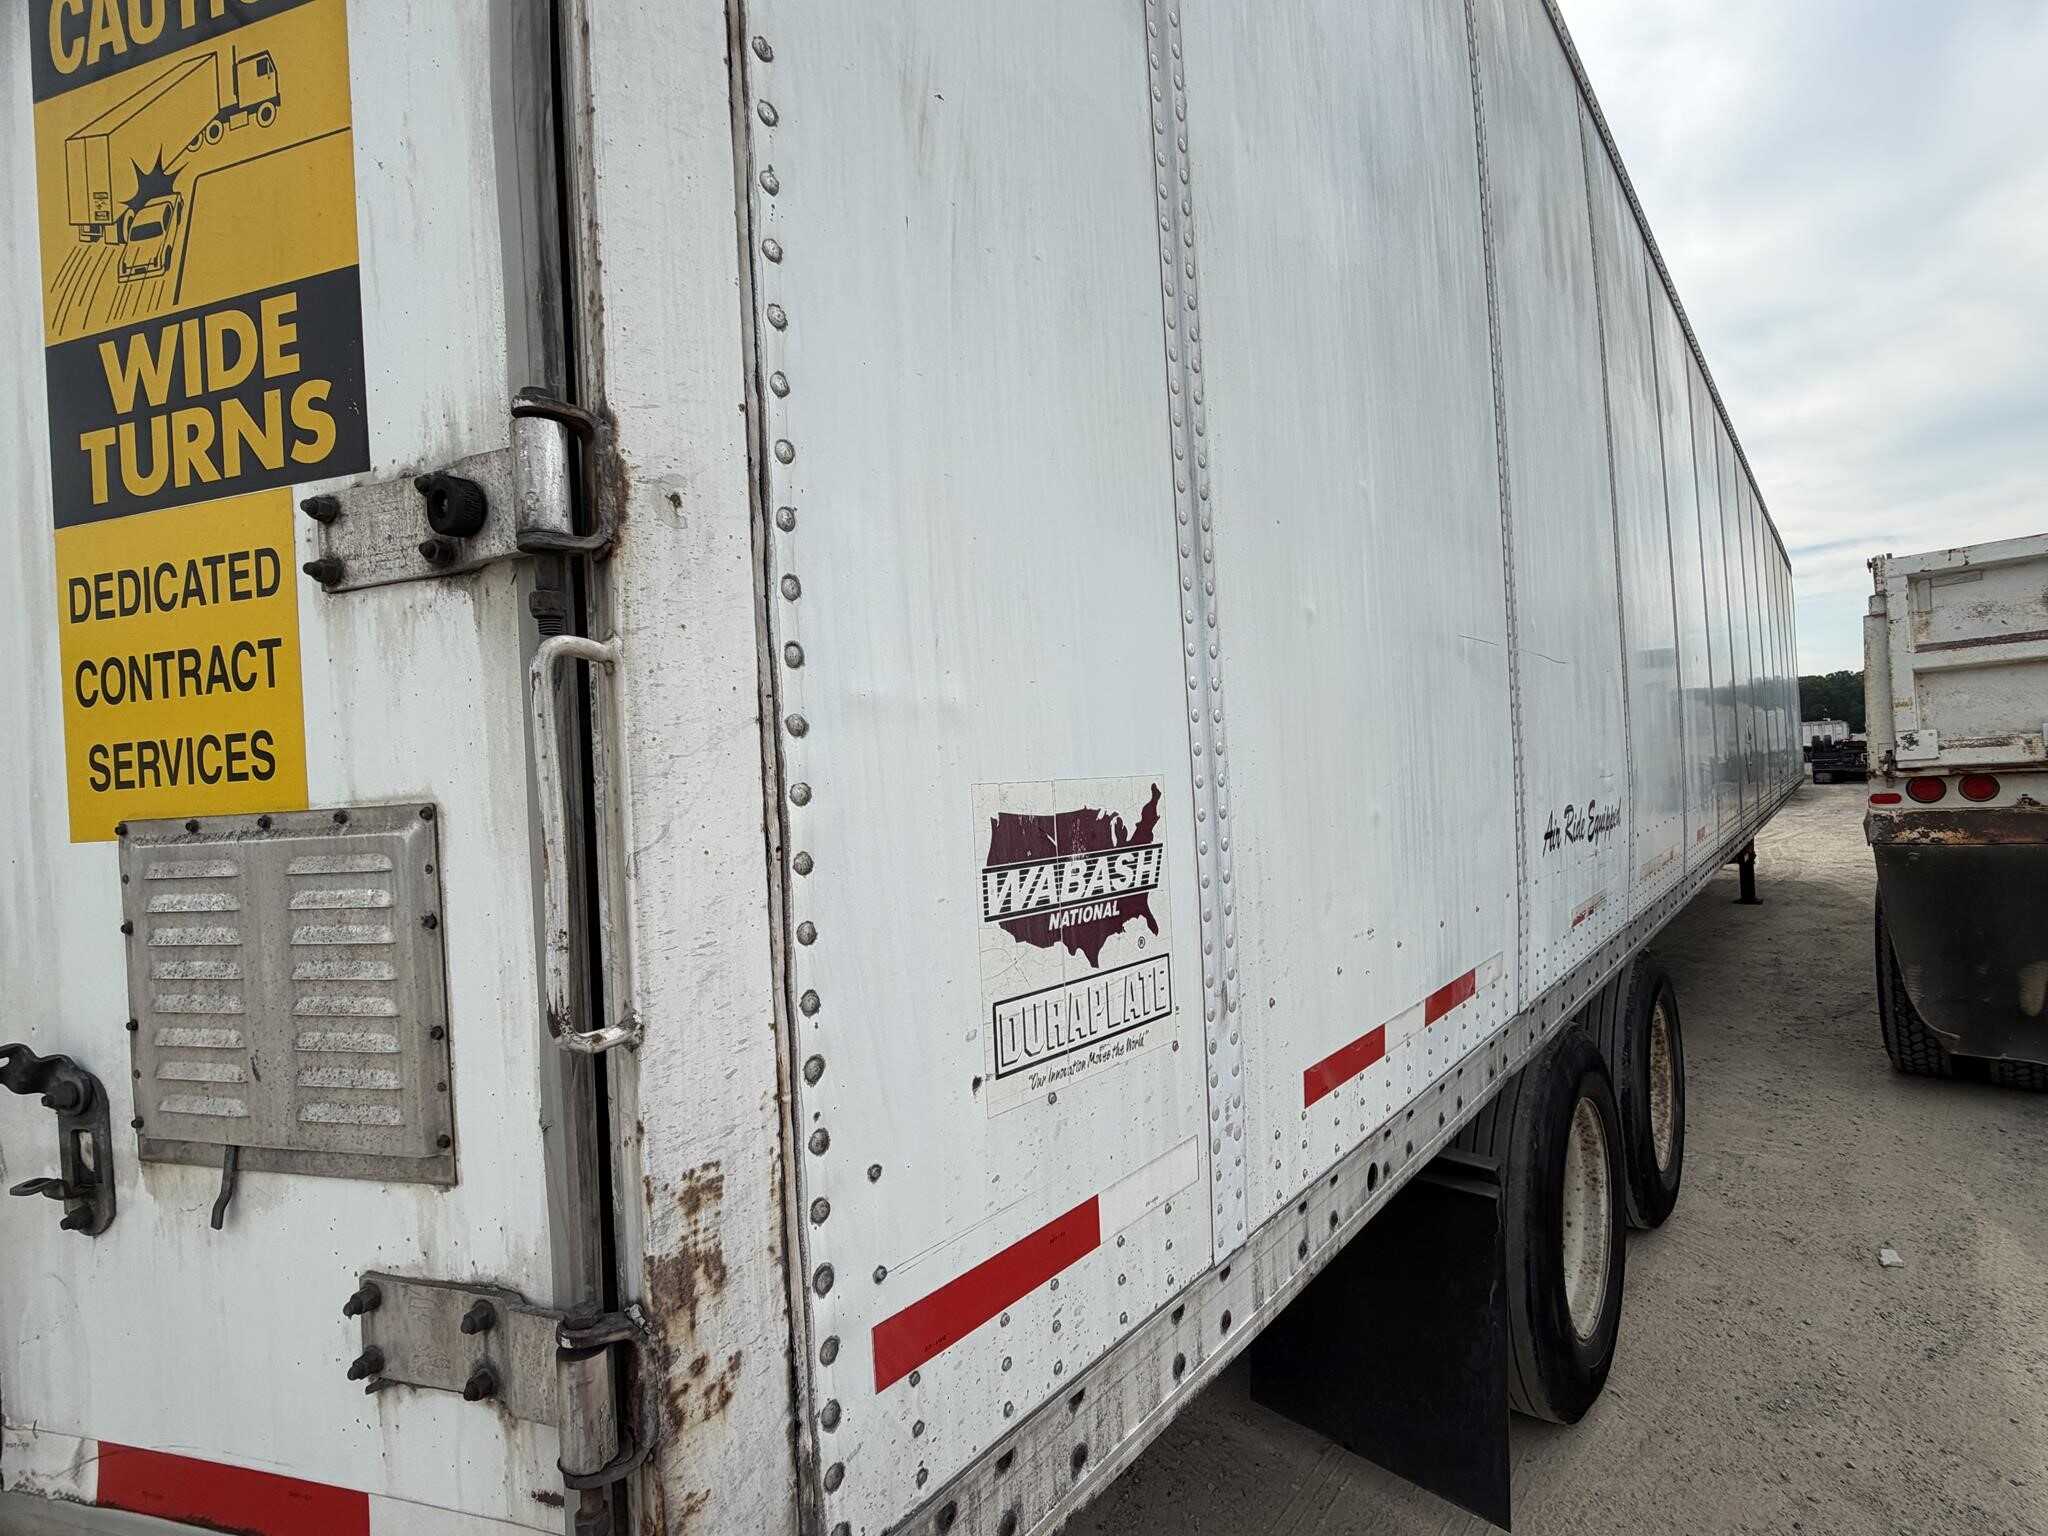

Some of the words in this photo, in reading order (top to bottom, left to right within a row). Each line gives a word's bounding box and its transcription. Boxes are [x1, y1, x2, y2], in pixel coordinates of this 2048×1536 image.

[98, 291, 301, 415] WIDE
[79, 379, 337, 506] TURNS
[68, 547, 281, 624] DEDICATED
[75, 637, 282, 708] CONTRACT
[88, 730, 276, 792] SERVICES
[1543, 810, 1560, 858] Air
[1564, 804, 1585, 845] Ride
[984, 847, 1160, 915] WABASH
[1049, 900, 1121, 930] NATIONAL
[999, 960, 1168, 1067] DURAPLATE
